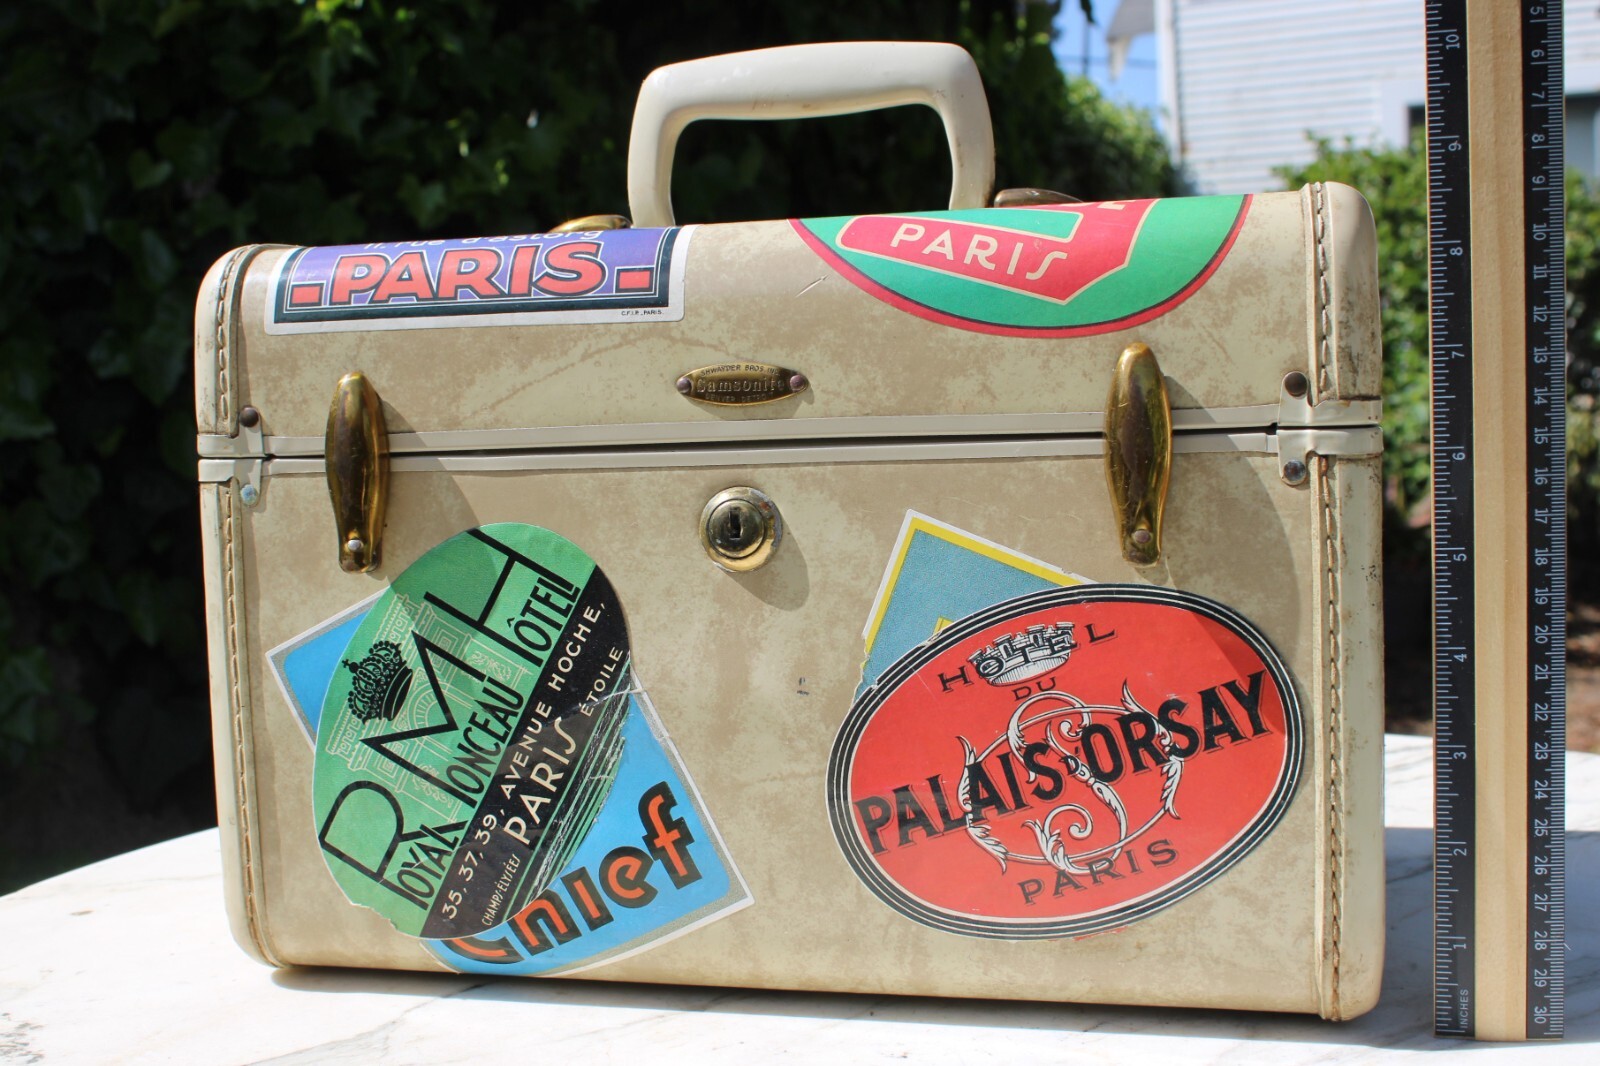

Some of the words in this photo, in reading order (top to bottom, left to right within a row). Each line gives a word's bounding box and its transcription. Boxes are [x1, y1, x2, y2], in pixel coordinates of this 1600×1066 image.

[1530, 6, 1544, 15] 5
[1446, 34, 1460, 50] 10
[1531, 49, 1545, 58] 6
[1532, 90, 1545, 99] 7
[1448, 141, 1461, 151] 9
[1531, 134, 1545, 143] 8
[1532, 175, 1545, 184] 9
[1533, 223, 1547, 241] 10
[889, 222, 1067, 281] PARIS
[1450, 247, 1463, 256] 8
[329, 240, 607, 305] PARIS
[1533, 264, 1547, 279] 11
[1533, 306, 1547, 323] 12
[1451, 351, 1464, 359] 7
[1534, 347, 1548, 364] 13
[701, 365, 741, 377] SHWAYDER
[697, 377, 785, 393] Samsonite
[1534, 387, 1548, 405] 14
[1534, 427, 1548, 445] 15
[1452, 452, 1466, 460] 6
[1535, 468, 1549, 485] 16
[1535, 509, 1549, 525] 17
[1453, 553, 1467, 562] 5
[1535, 548, 1549, 566] 18
[1535, 587, 1549, 605] 19
[1535, 625, 1549, 644] 20
[1453, 653, 1468, 662] 4
[579, 646, 623, 717] ÉTOILE
[1535, 664, 1549, 681] 21
[1012, 675, 1058, 702] DU
[500, 701, 552, 799] AVENUE
[547, 603, 605, 691] HOCHE,
[1535, 703, 1549, 722] 22
[1453, 751, 1467, 760] 3
[1535, 742, 1549, 760] 23
[854, 742, 1066, 856] PALAIS
[1060, 669, 1274, 786] D'ORSAY
[503, 716, 577, 845] PARIS
[1534, 780, 1548, 799] 24
[1534, 819, 1548, 837] 25
[1453, 848, 1467, 857] 2
[1017, 838, 1179, 905] PARIS
[1534, 856, 1548, 875] 26
[1534, 894, 1548, 912] 27
[1453, 942, 1467, 950] 1
[1534, 931, 1548, 950] 28
[1534, 969, 1548, 988] 29
[1460, 988, 1469, 1029] INCHES
[1534, 1006, 1548, 1024] 30
